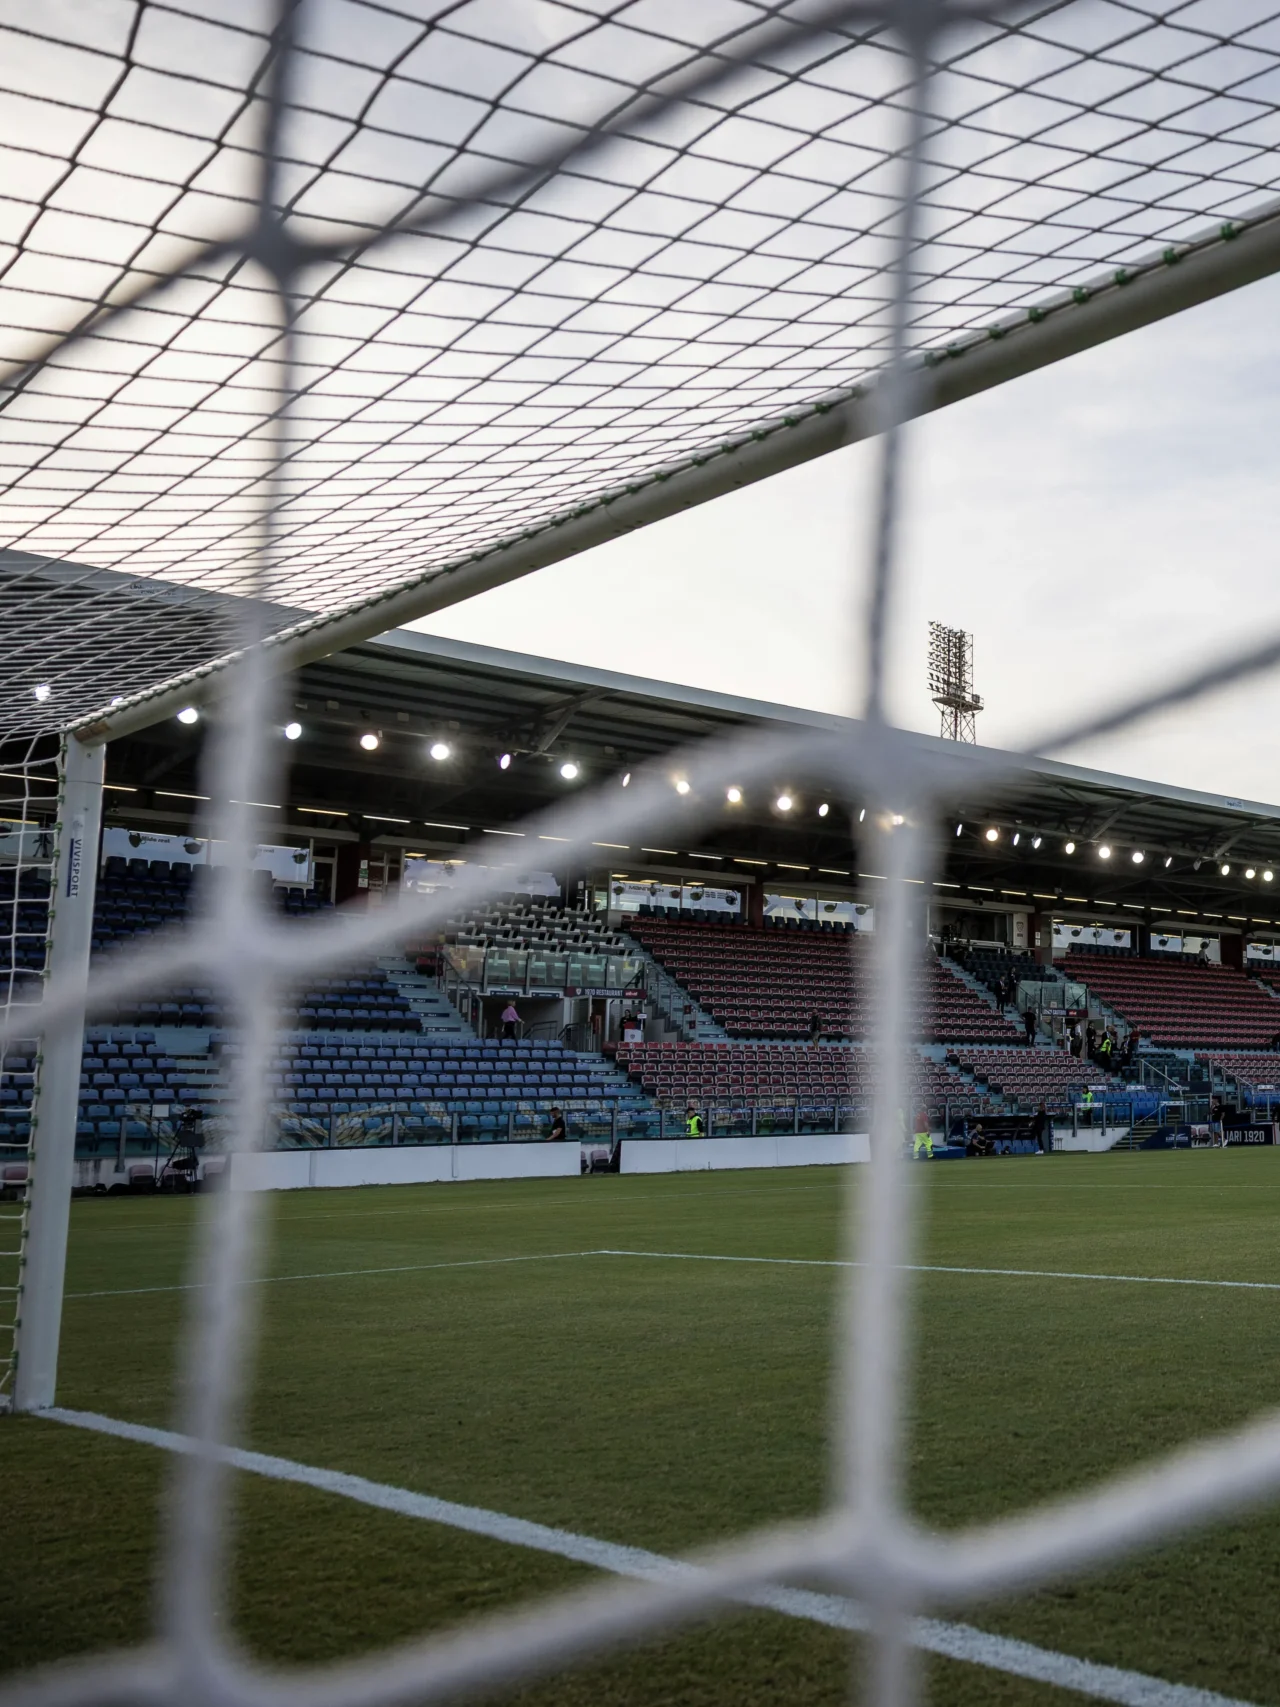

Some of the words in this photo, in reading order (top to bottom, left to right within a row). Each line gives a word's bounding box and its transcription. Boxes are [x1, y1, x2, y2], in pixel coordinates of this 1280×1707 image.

[71, 838, 82, 897] VIVISPORT
[584, 988, 596, 996] 1970
[596, 988, 623, 997] RESTAURANT
[1244, 1130, 1265, 1142] 1920
